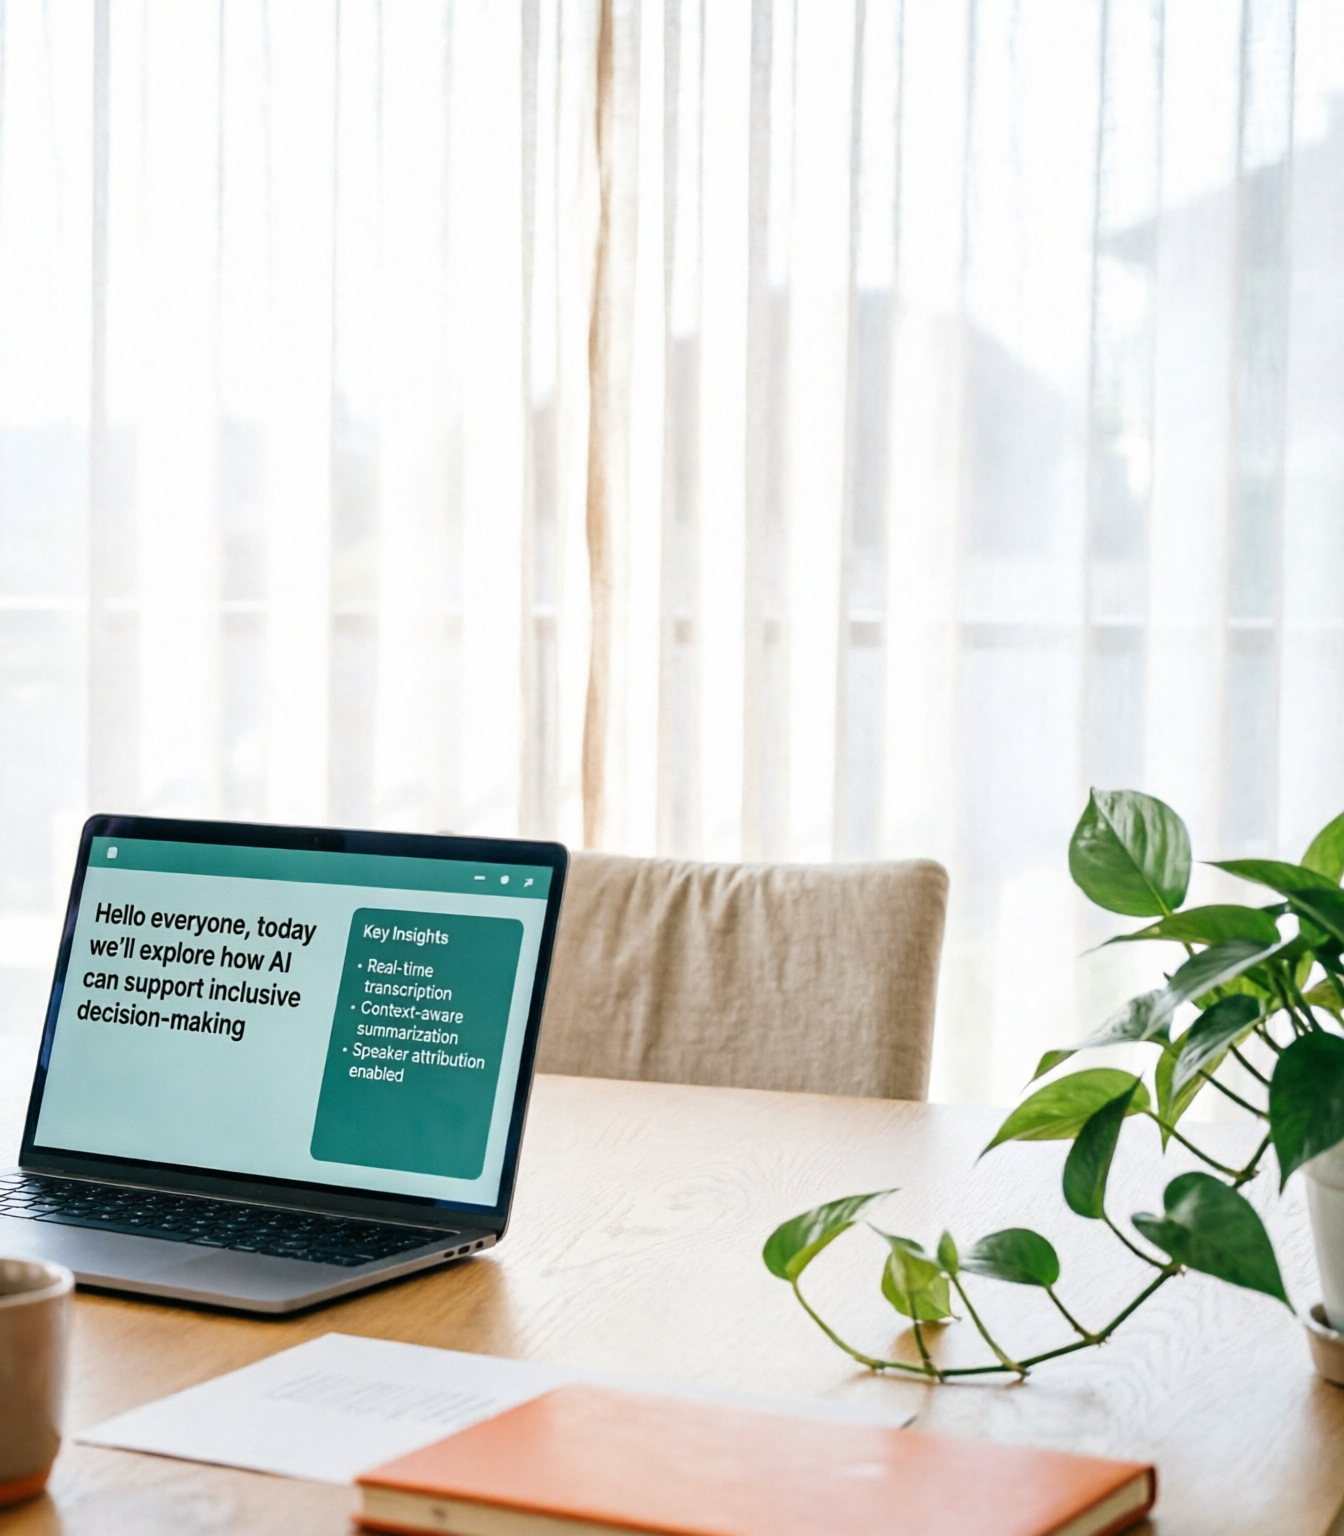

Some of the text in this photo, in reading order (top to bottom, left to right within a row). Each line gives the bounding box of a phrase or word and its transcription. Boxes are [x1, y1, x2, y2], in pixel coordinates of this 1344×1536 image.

[95, 902, 317, 946] Hello everyone, today
[363, 924, 449, 946] Key Insights
[140, 942, 215, 967] explore
[220, 946, 265, 970] how
[268, 951, 292, 973] AI
[367, 958, 434, 977] Real-time
[83, 971, 301, 1007] can support inclusive
[364, 980, 452, 1001] transcription
[77, 1000, 245, 1041] decision-making
[361, 1001, 463, 1023] Context-aware
[357, 1024, 458, 1045] summarization
[352, 1042, 485, 1069] Speaker attribution
[349, 1065, 404, 1082] enabled
